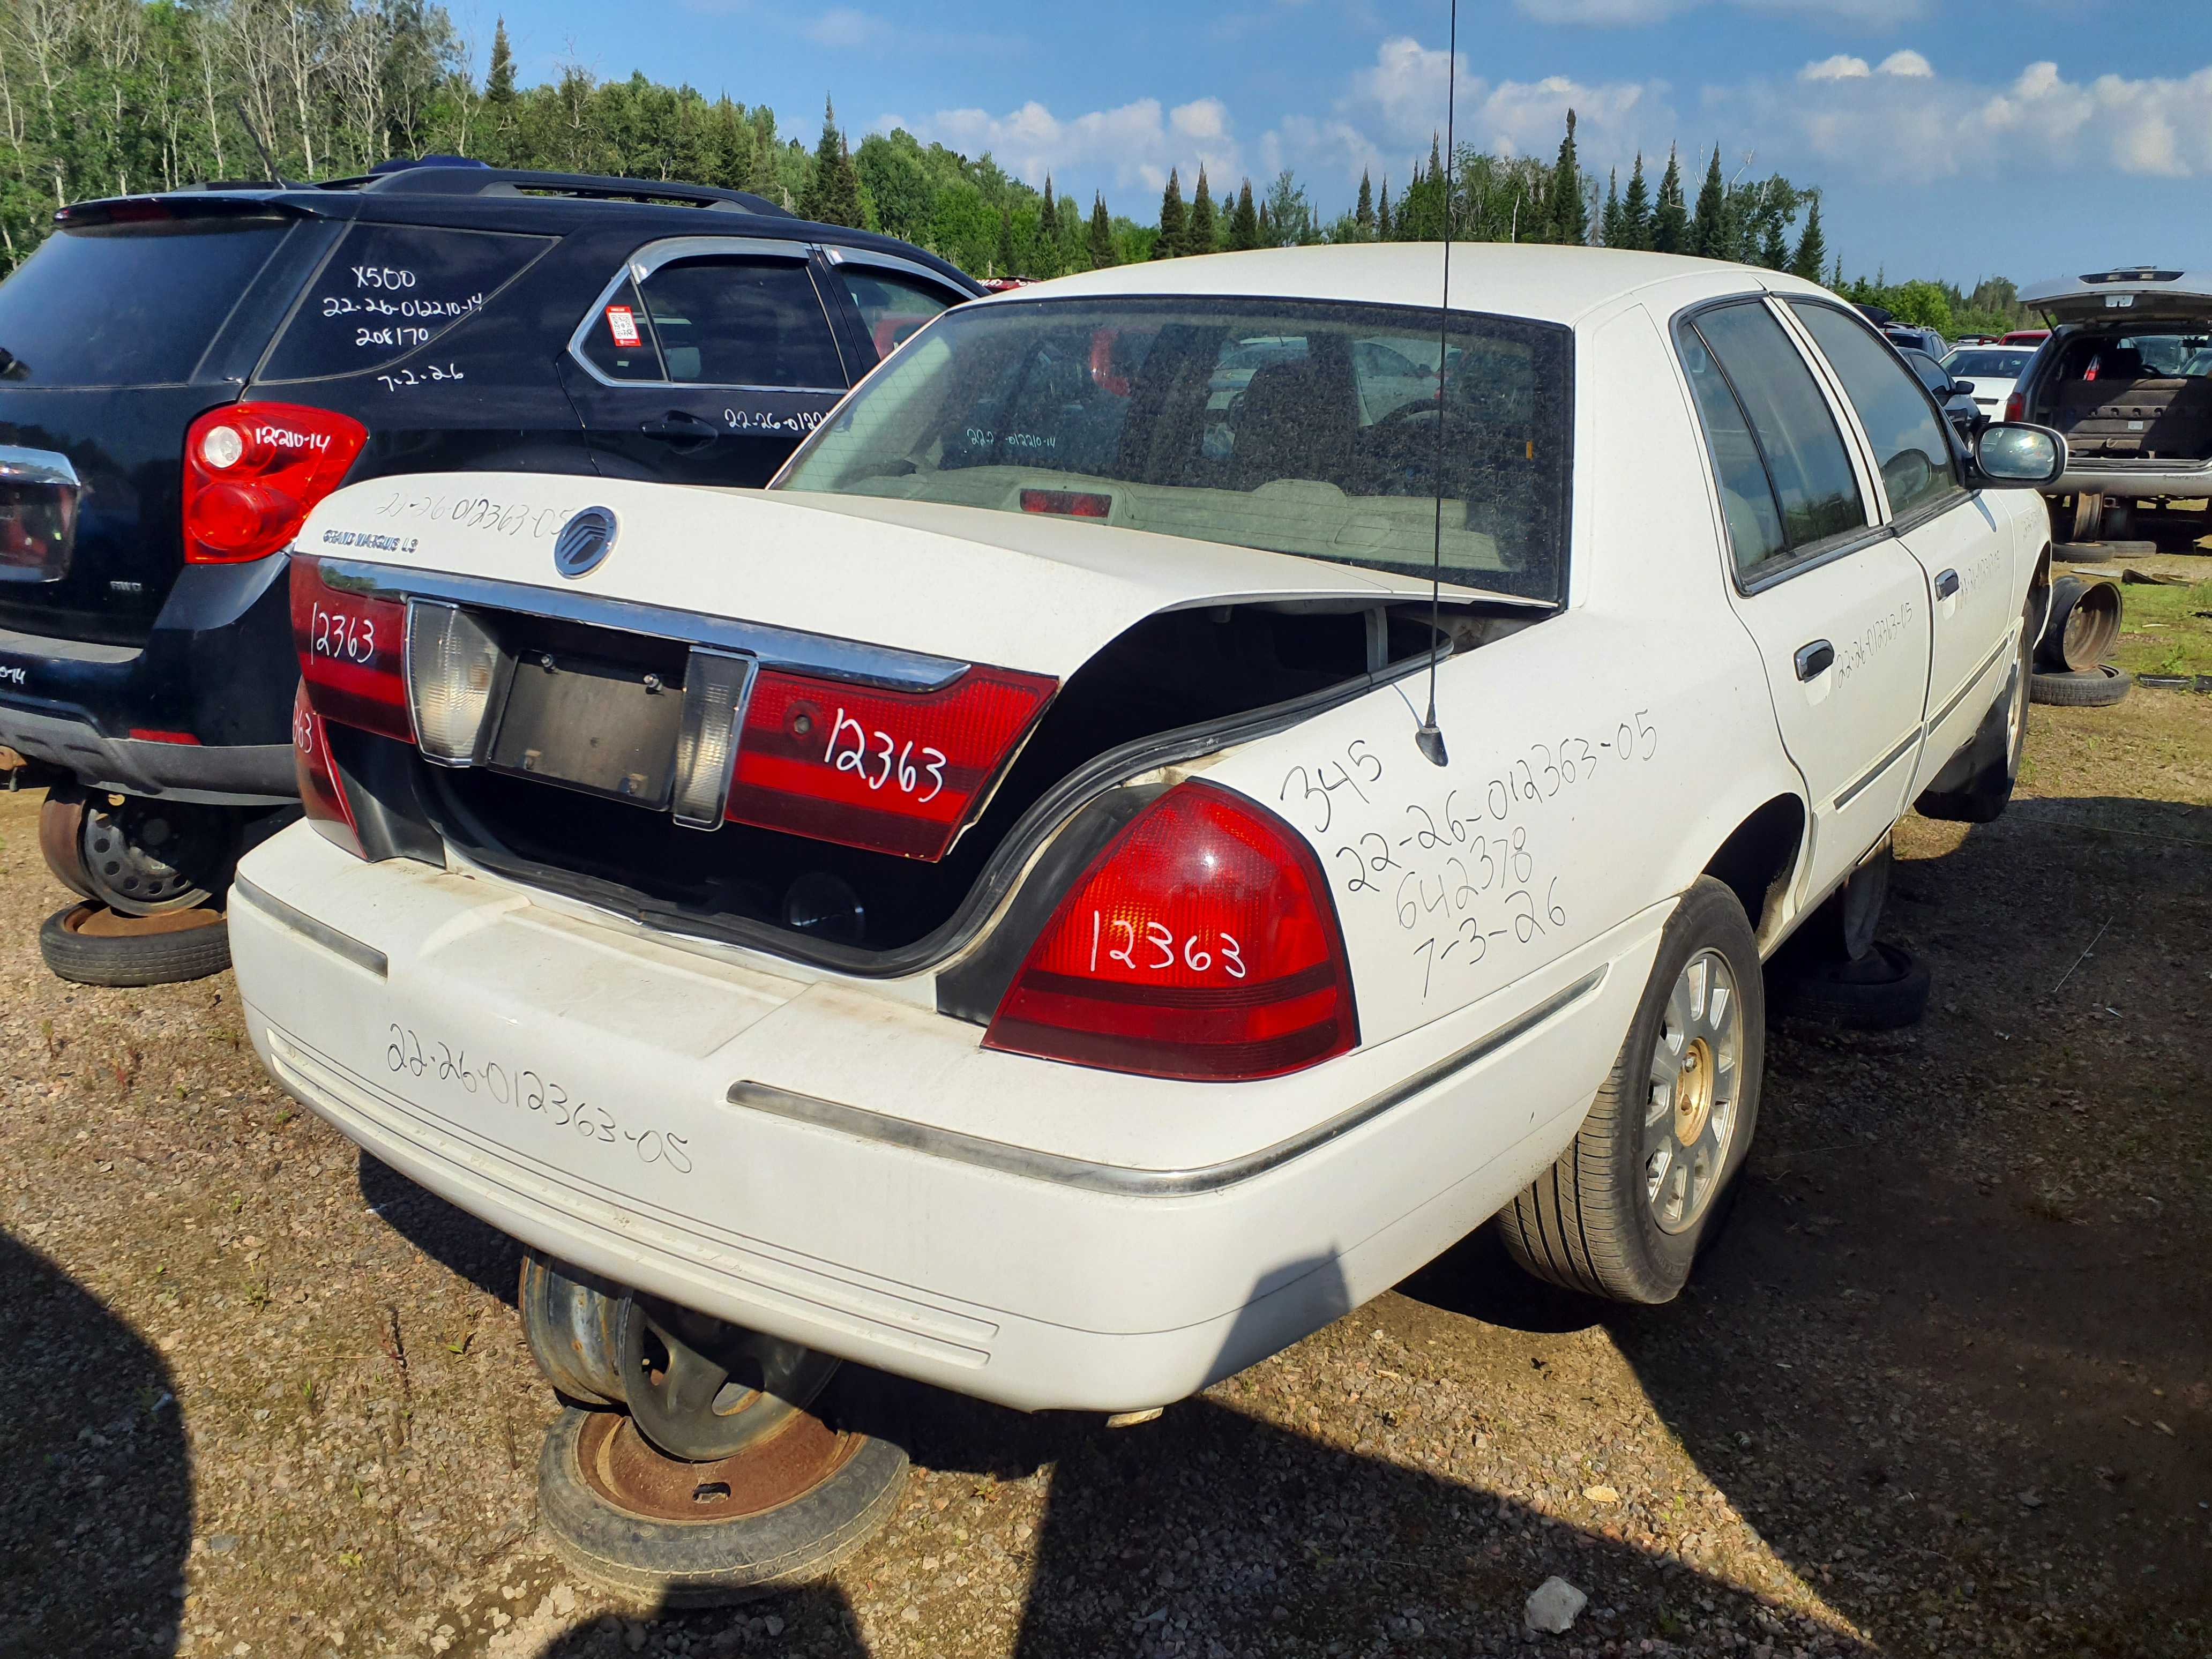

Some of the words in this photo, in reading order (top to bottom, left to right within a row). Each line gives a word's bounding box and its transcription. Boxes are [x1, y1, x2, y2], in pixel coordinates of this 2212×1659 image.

[352, 267, 416, 290] X500
[356, 327, 429, 346] 208170
[323, 529, 356, 545] GRAND
[311, 601, 375, 664] 12363
[824, 708, 947, 803] 12363
[1280, 739, 1382, 833] 345
[1336, 708, 1658, 892] 22-26-012363-05
[1396, 826, 1533, 930] 642378
[1090, 910, 1246, 978] 12363
[1413, 876, 1567, 1000] 7-3-26
[386, 1023, 693, 1174] 22-26-012363-05
